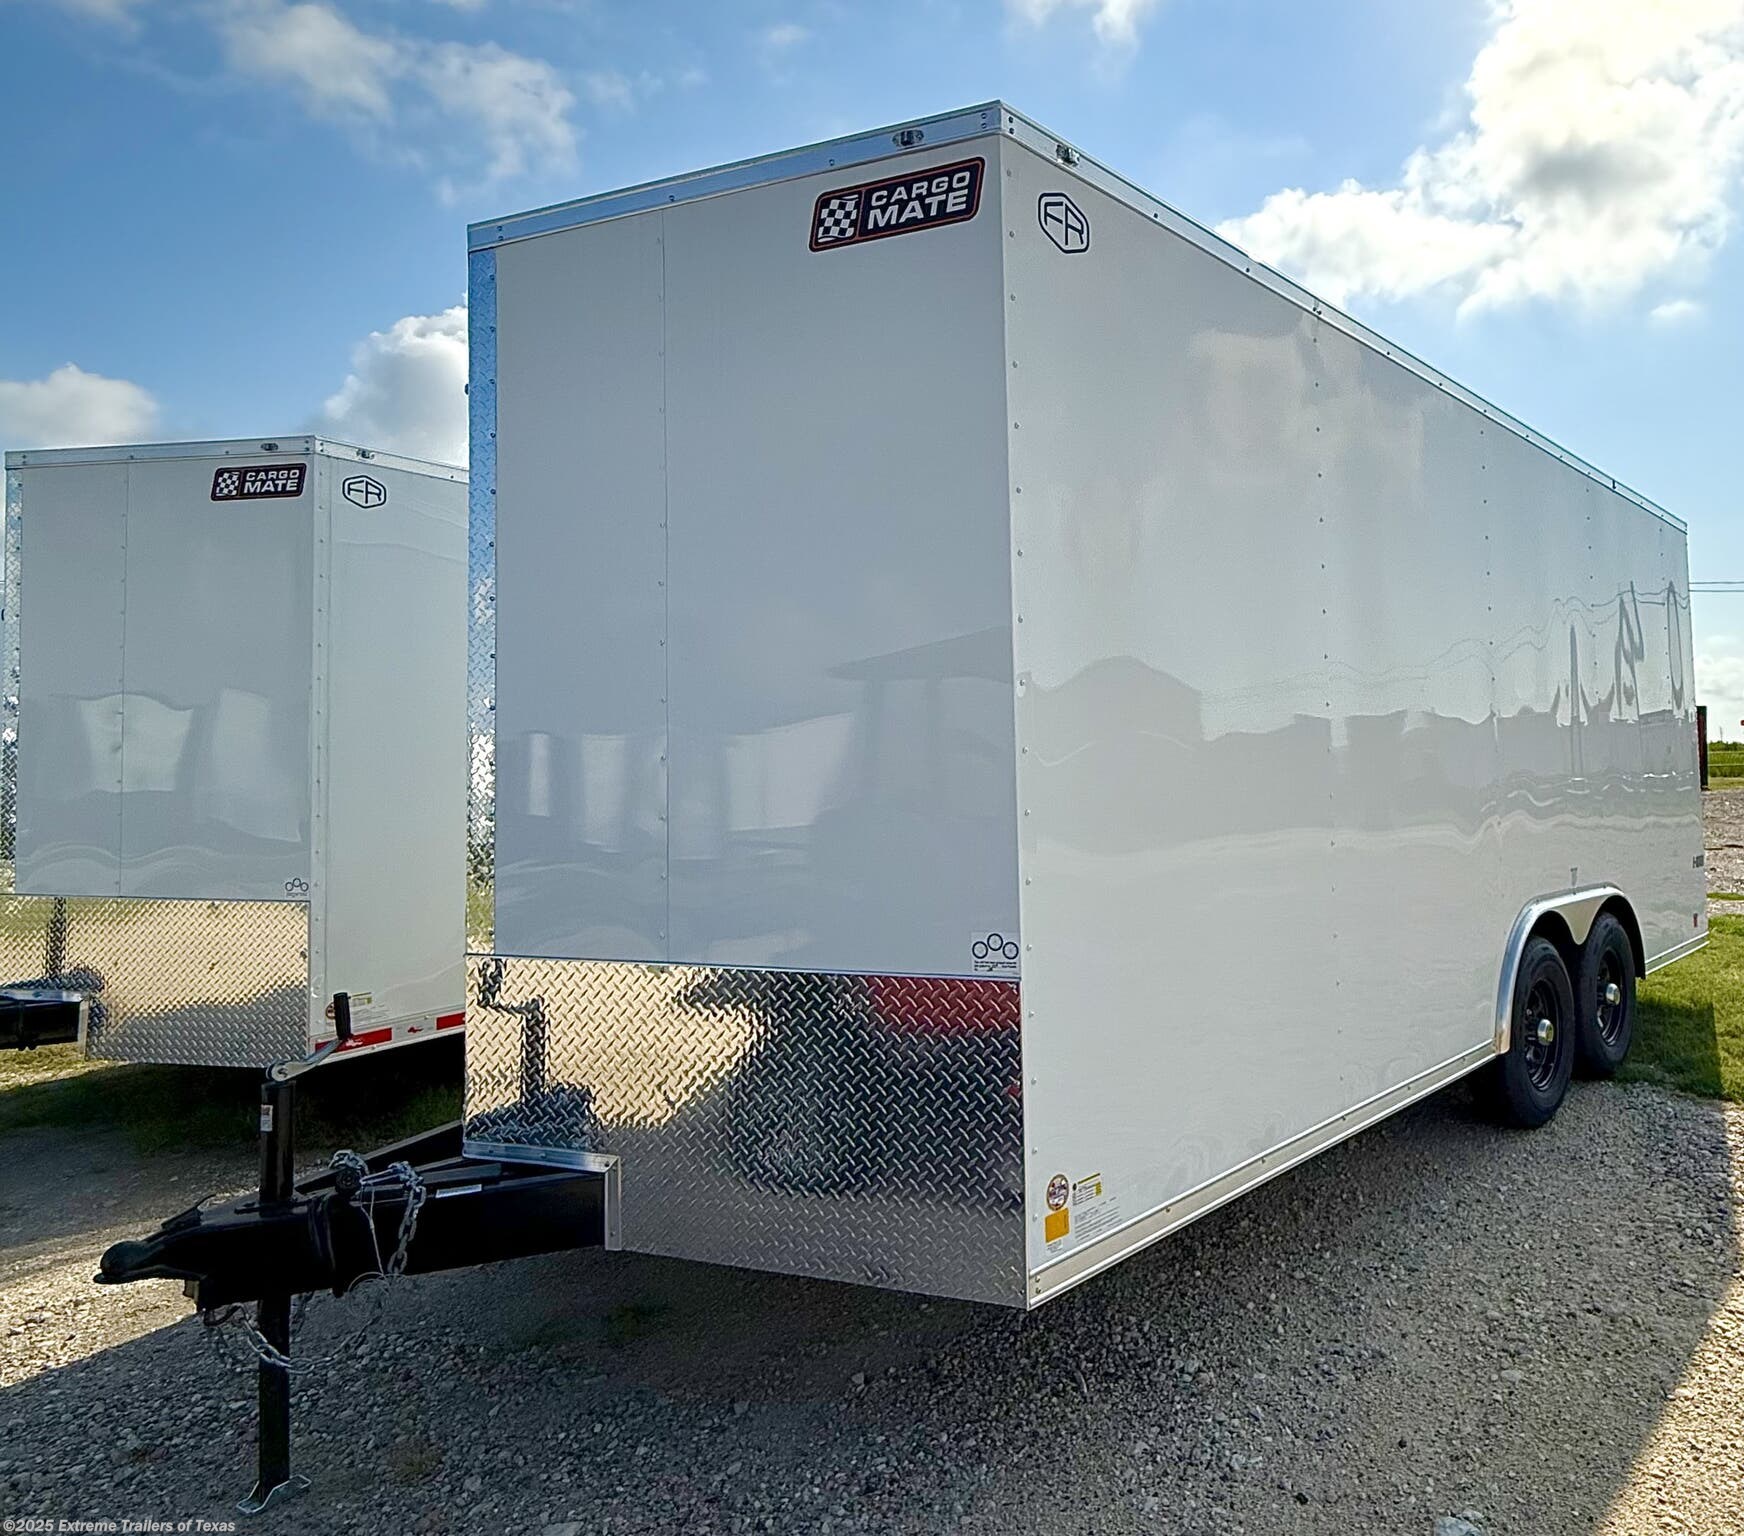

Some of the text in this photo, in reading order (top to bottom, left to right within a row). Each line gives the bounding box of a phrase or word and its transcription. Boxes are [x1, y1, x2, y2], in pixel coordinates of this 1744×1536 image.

[871, 171, 970, 207] CARGO
[867, 189, 969, 230] MATE
[243, 479, 298, 494] MATE
[246, 469, 300, 481] CARGO
